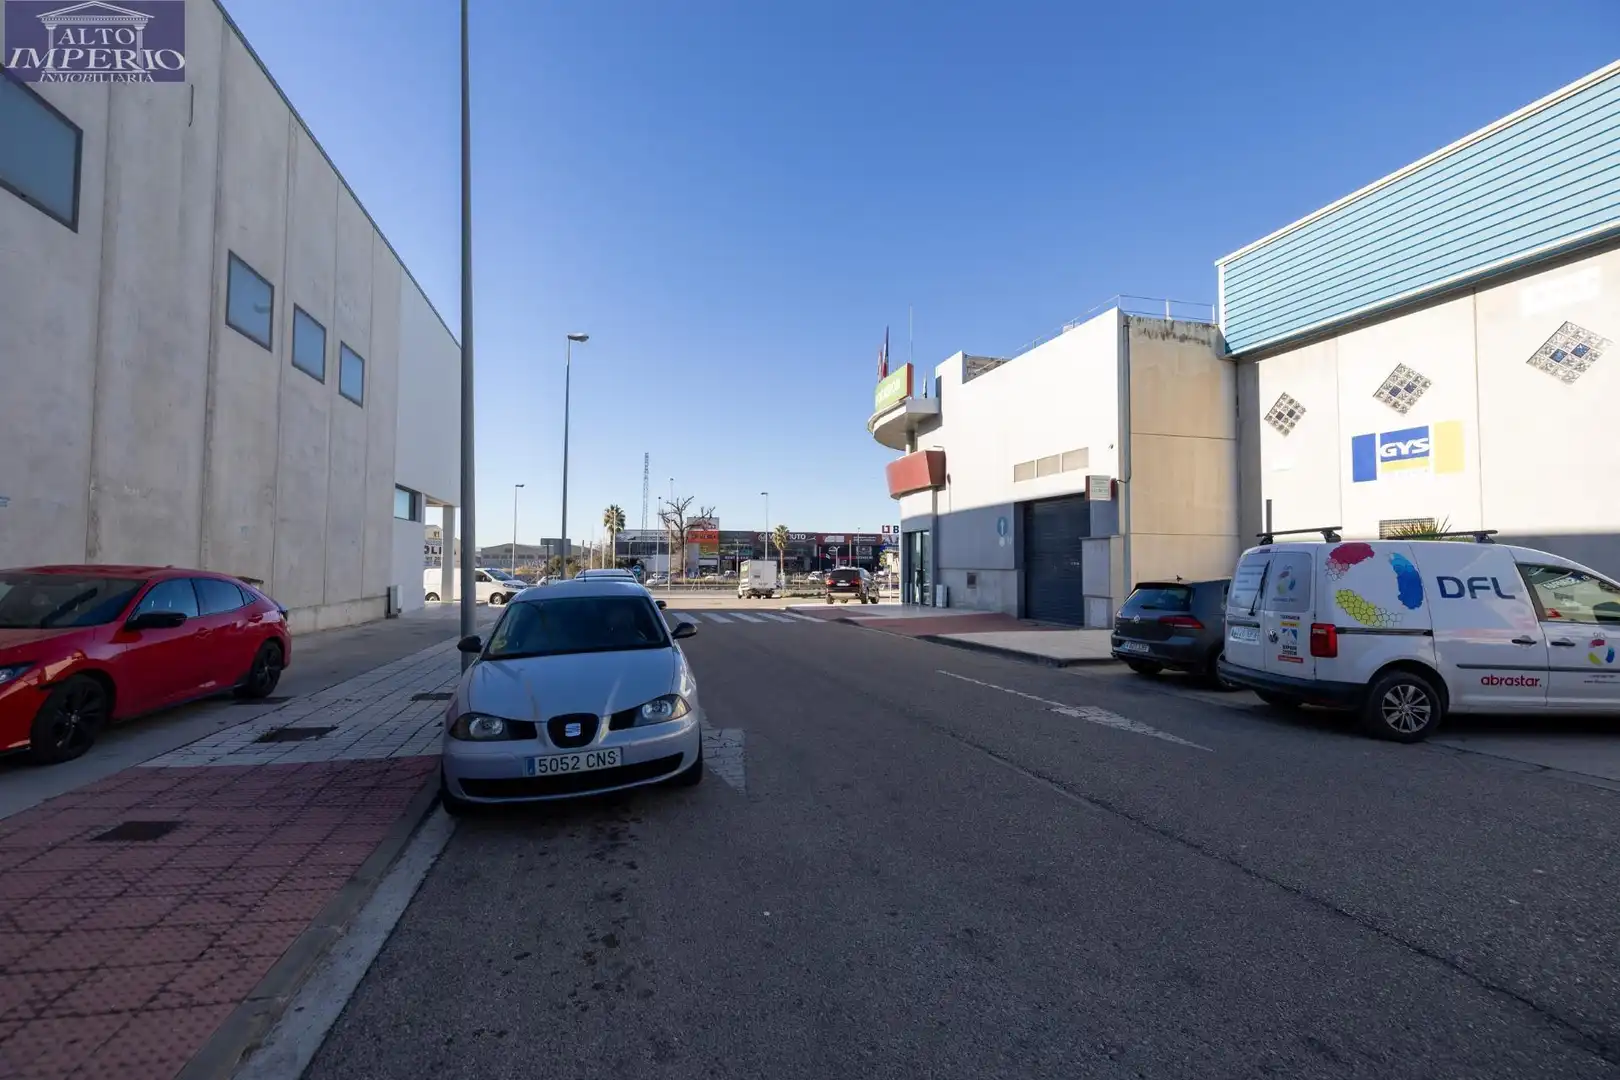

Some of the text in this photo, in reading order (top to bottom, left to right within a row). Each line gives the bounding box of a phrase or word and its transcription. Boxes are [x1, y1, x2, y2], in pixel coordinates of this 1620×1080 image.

[1380, 437, 1430, 457] GYS
[1436, 576, 1516, 600] DFL
[1480, 674, 1542, 688] abrastar.
[538, 750, 617, 774] 5052 CNS
